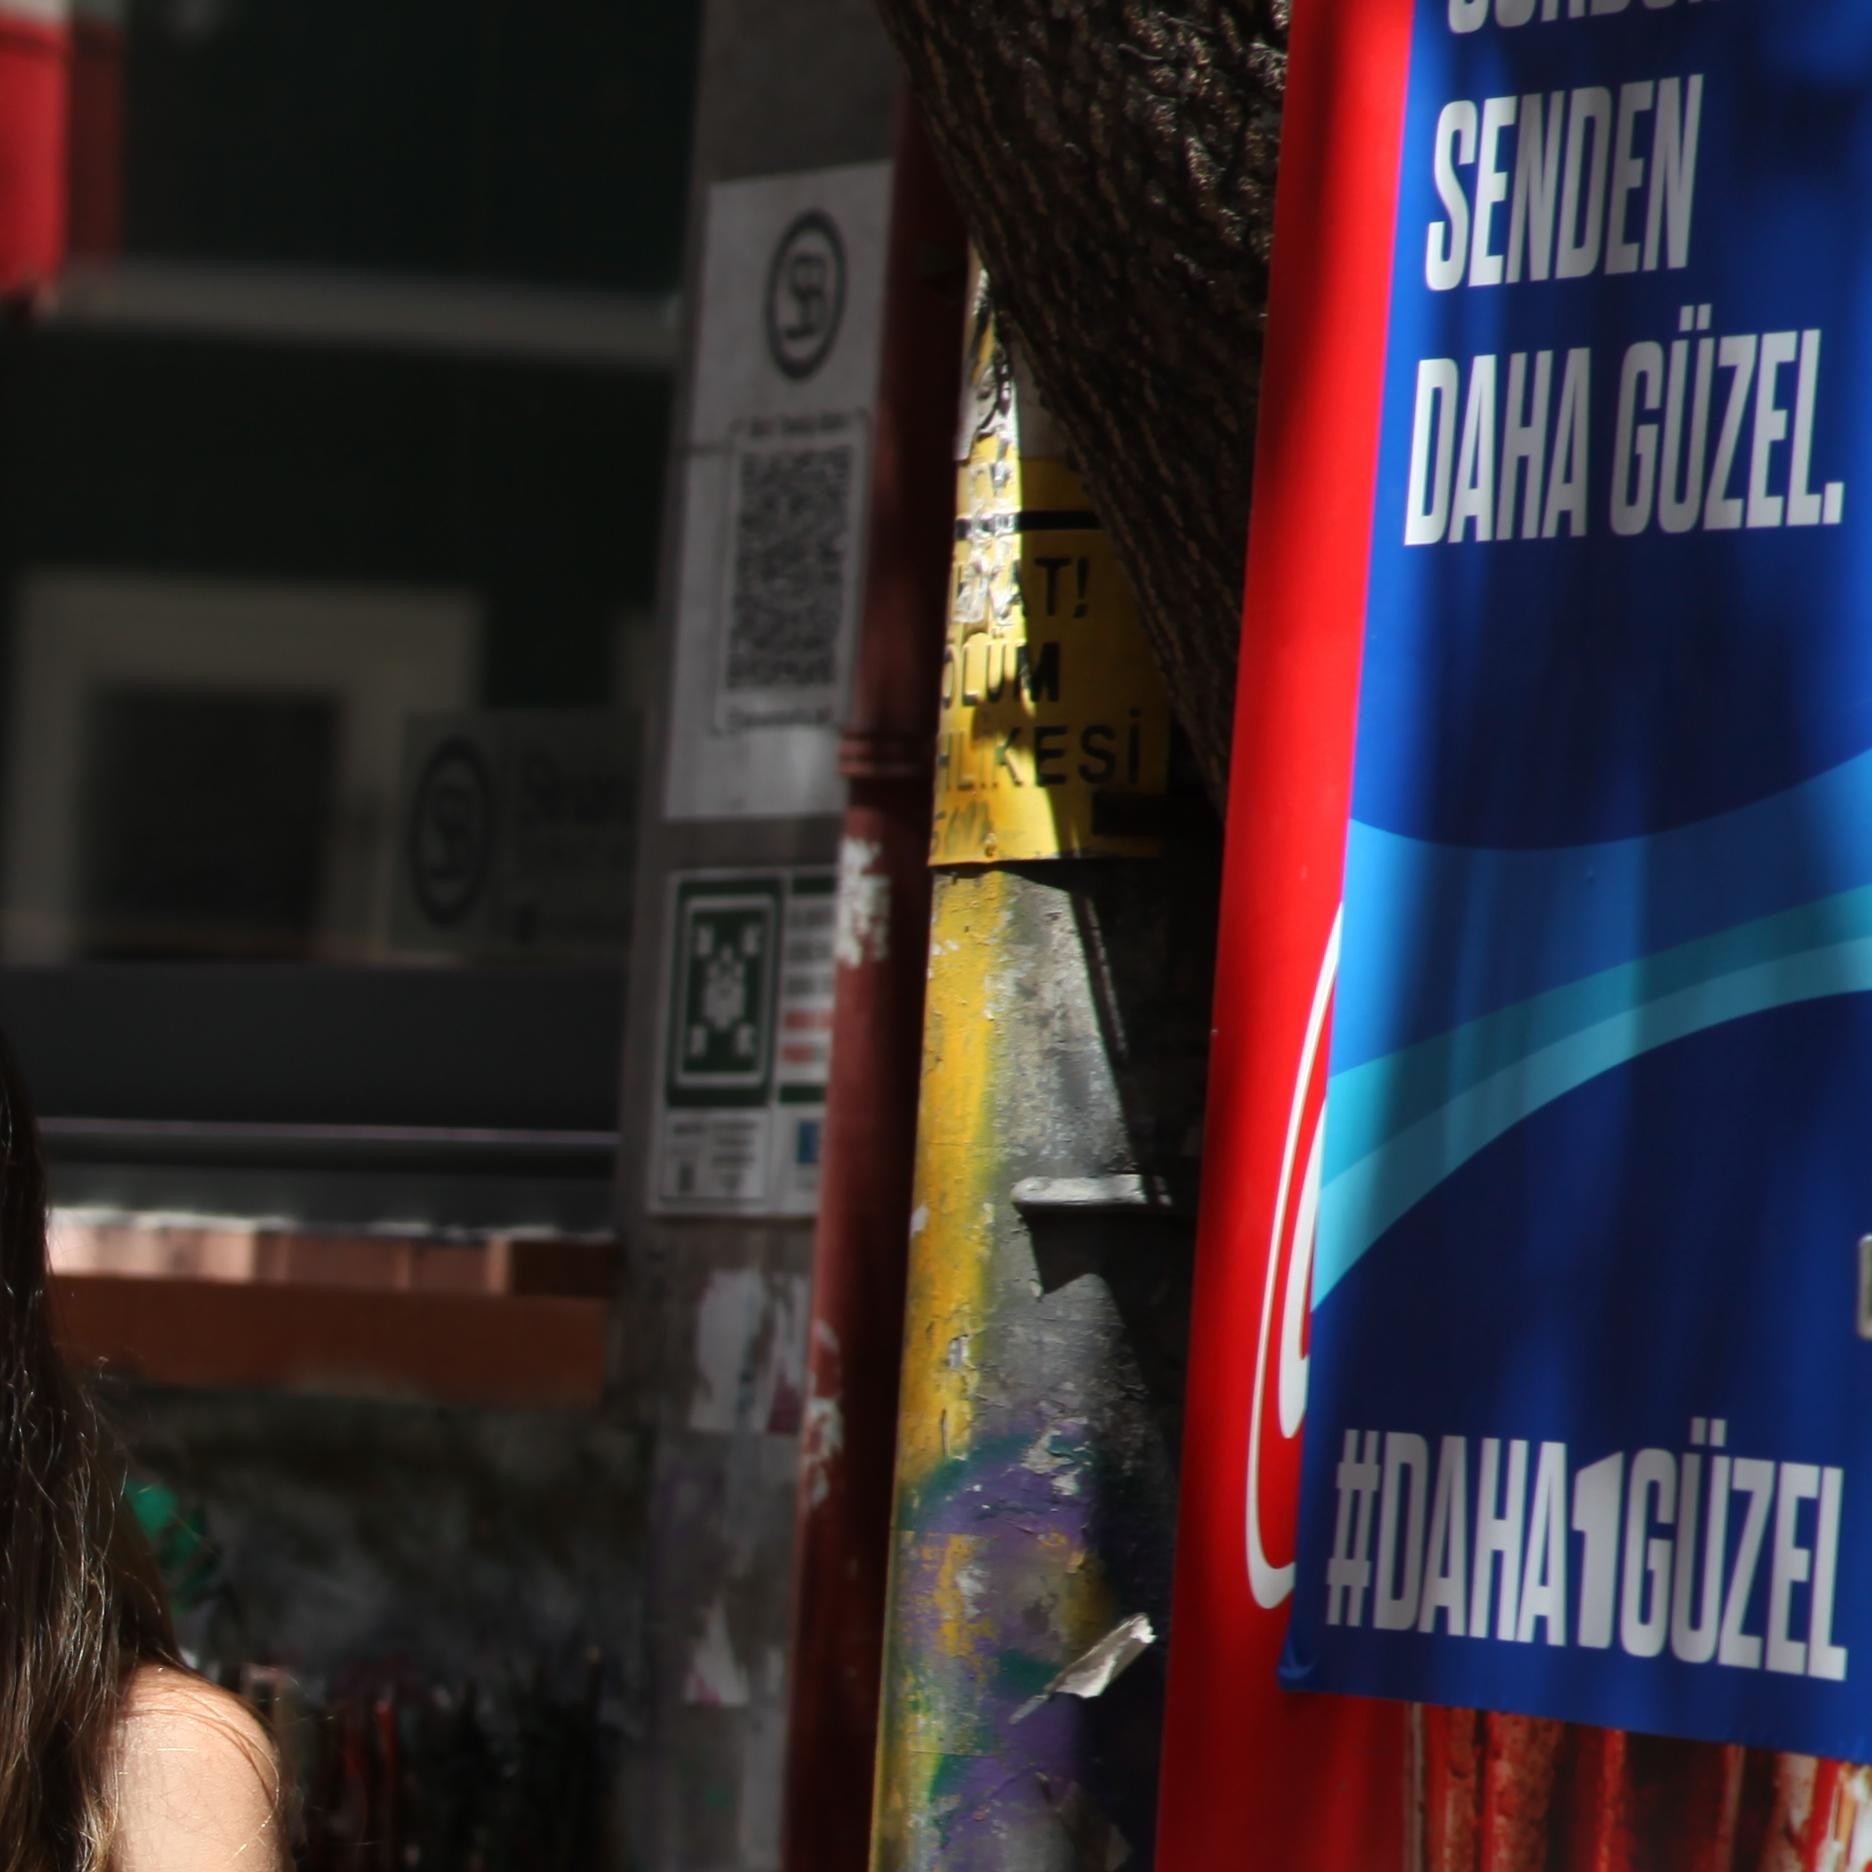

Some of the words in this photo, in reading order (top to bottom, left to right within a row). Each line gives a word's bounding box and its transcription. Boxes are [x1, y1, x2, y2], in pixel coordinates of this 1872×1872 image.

[1425, 74, 1703, 291] SENDEN
[1404, 347, 1591, 545] DAHA
[1609, 303, 1844, 535] GÜZEL.
[1326, 1417, 1847, 1681] #DAHA1GÜZEL
